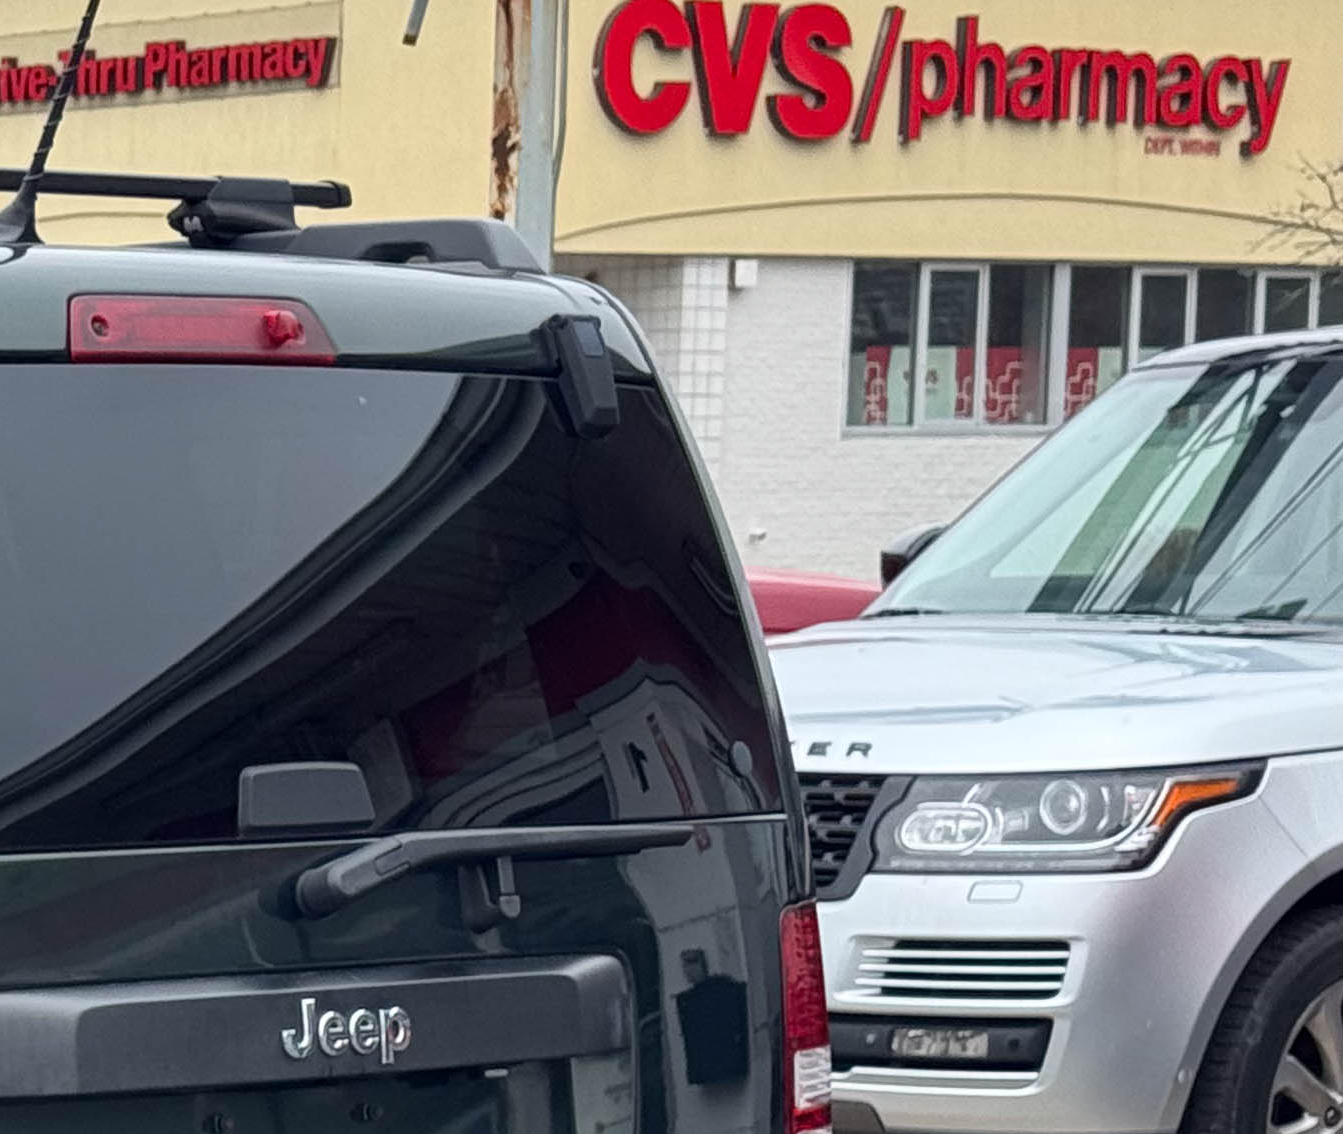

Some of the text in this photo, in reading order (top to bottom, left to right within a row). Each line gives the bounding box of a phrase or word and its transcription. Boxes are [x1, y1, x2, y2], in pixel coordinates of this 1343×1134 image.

[144, 37, 329, 88] Pharmacy
[593, 0, 1291, 156] CVS/pharmacy
[281, 998, 412, 1064] Jeep
